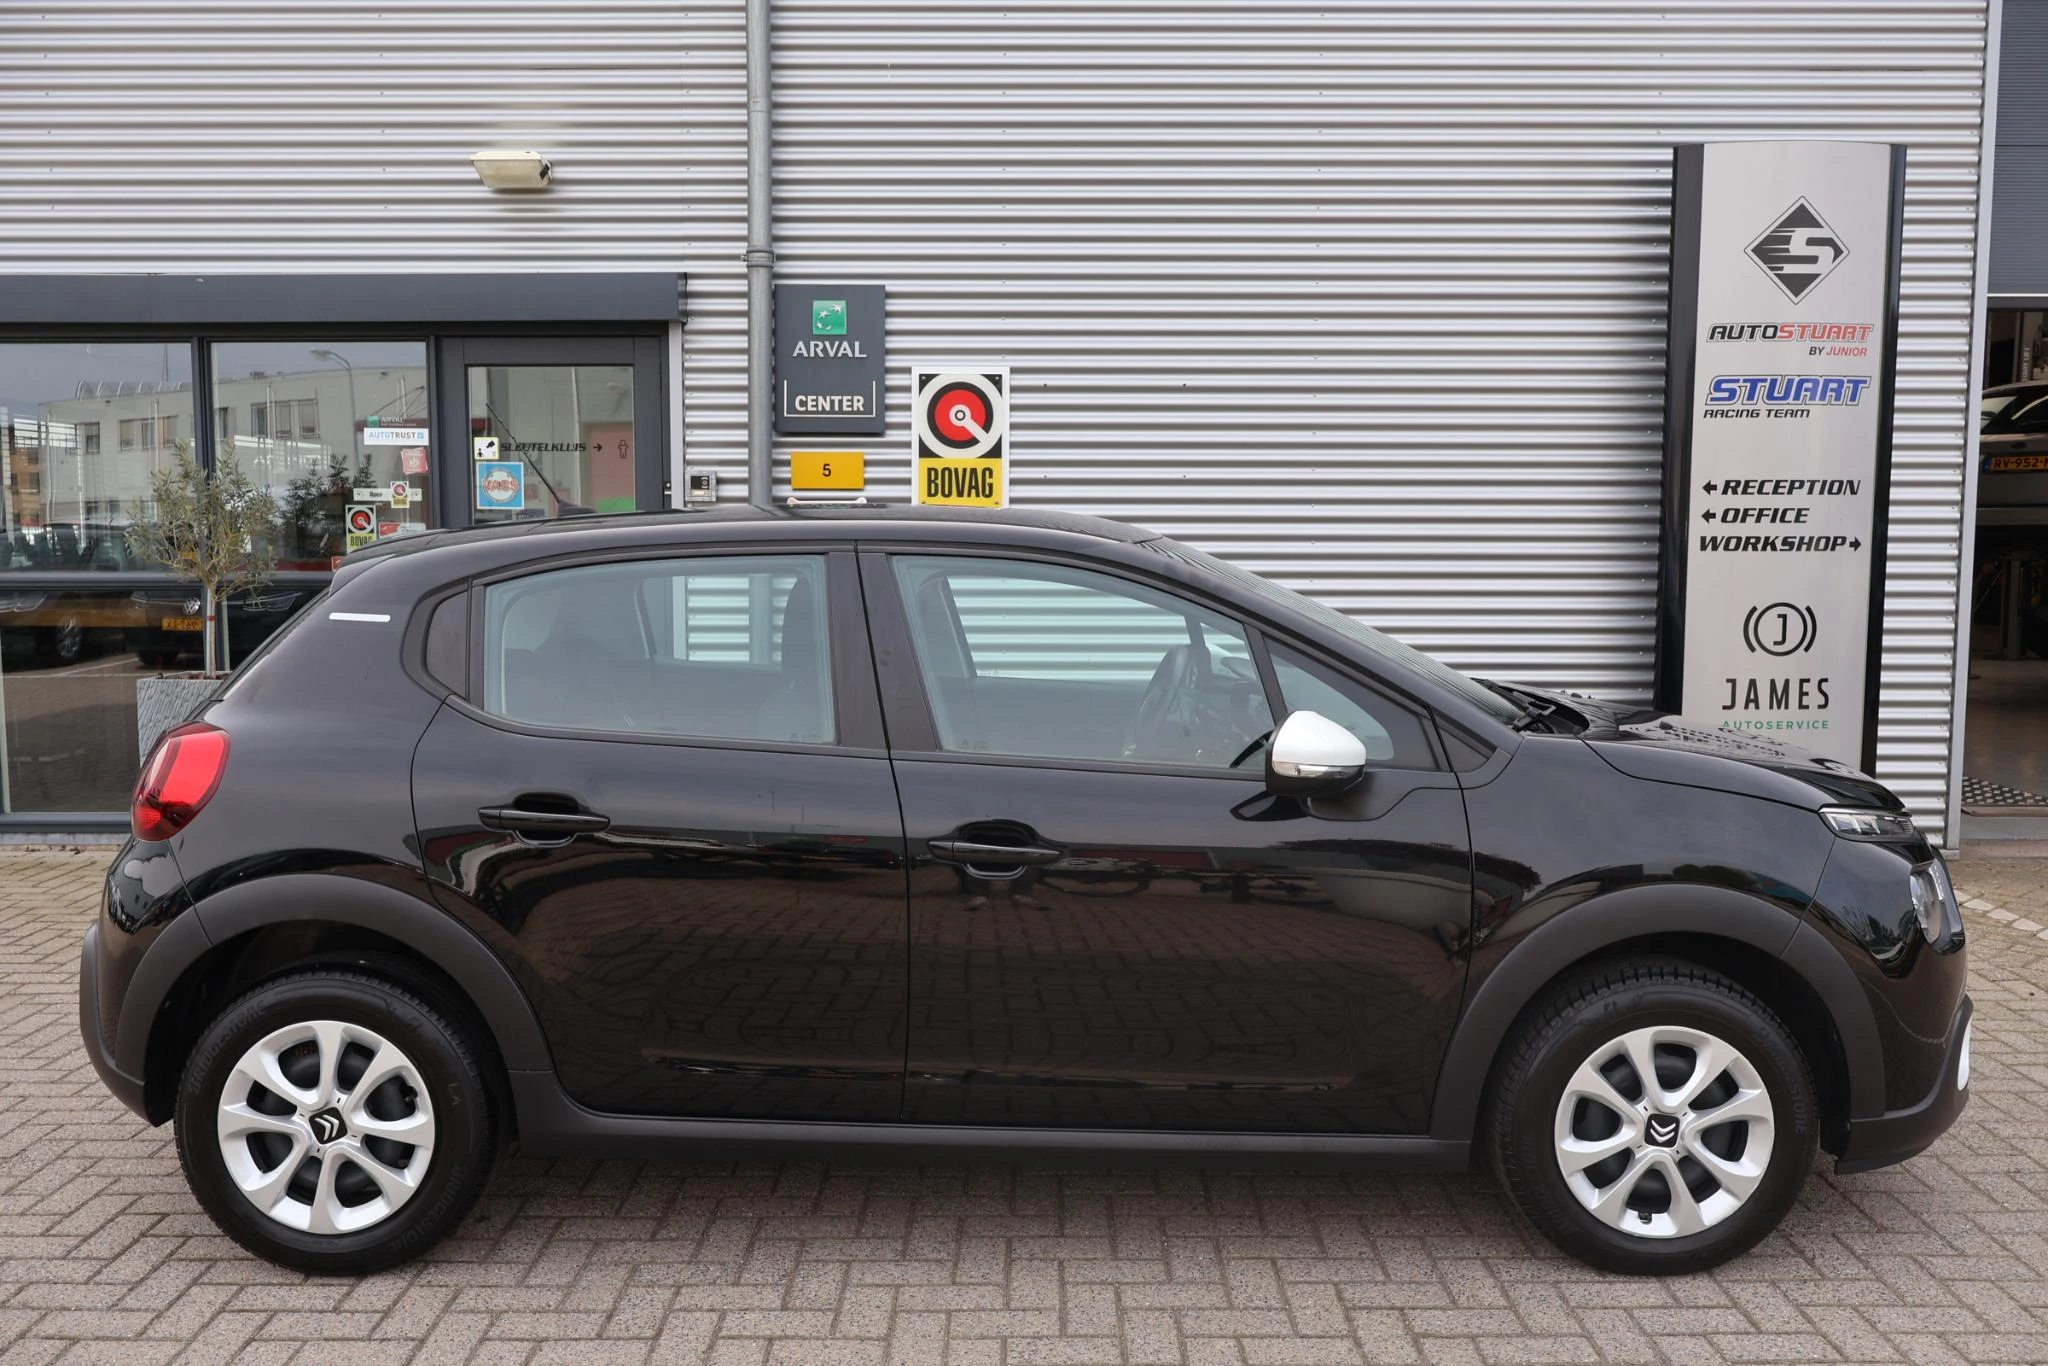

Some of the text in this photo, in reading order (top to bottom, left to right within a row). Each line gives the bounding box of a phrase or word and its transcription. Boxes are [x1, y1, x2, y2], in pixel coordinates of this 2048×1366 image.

[1706, 323, 1874, 343] AUTOSTUART
[792, 340, 867, 358] ARVAL
[1809, 346, 1868, 357] BY JUNIOR
[1705, 375, 1872, 406] STUART
[795, 395, 864, 412] CENTER
[1703, 409, 1810, 418] RACING TEAM
[368, 431, 416, 439] AUTOTRUST
[822, 463, 832, 477] 5
[926, 466, 994, 499] BOVAG
[1721, 479, 1861, 496] RECEPTION
[1720, 507, 1810, 524] OFFICE
[1699, 535, 1847, 552] WORKSHOP
[1722, 677, 1830, 711] JAMES
[1723, 720, 1830, 731] AUTOSERVICE
